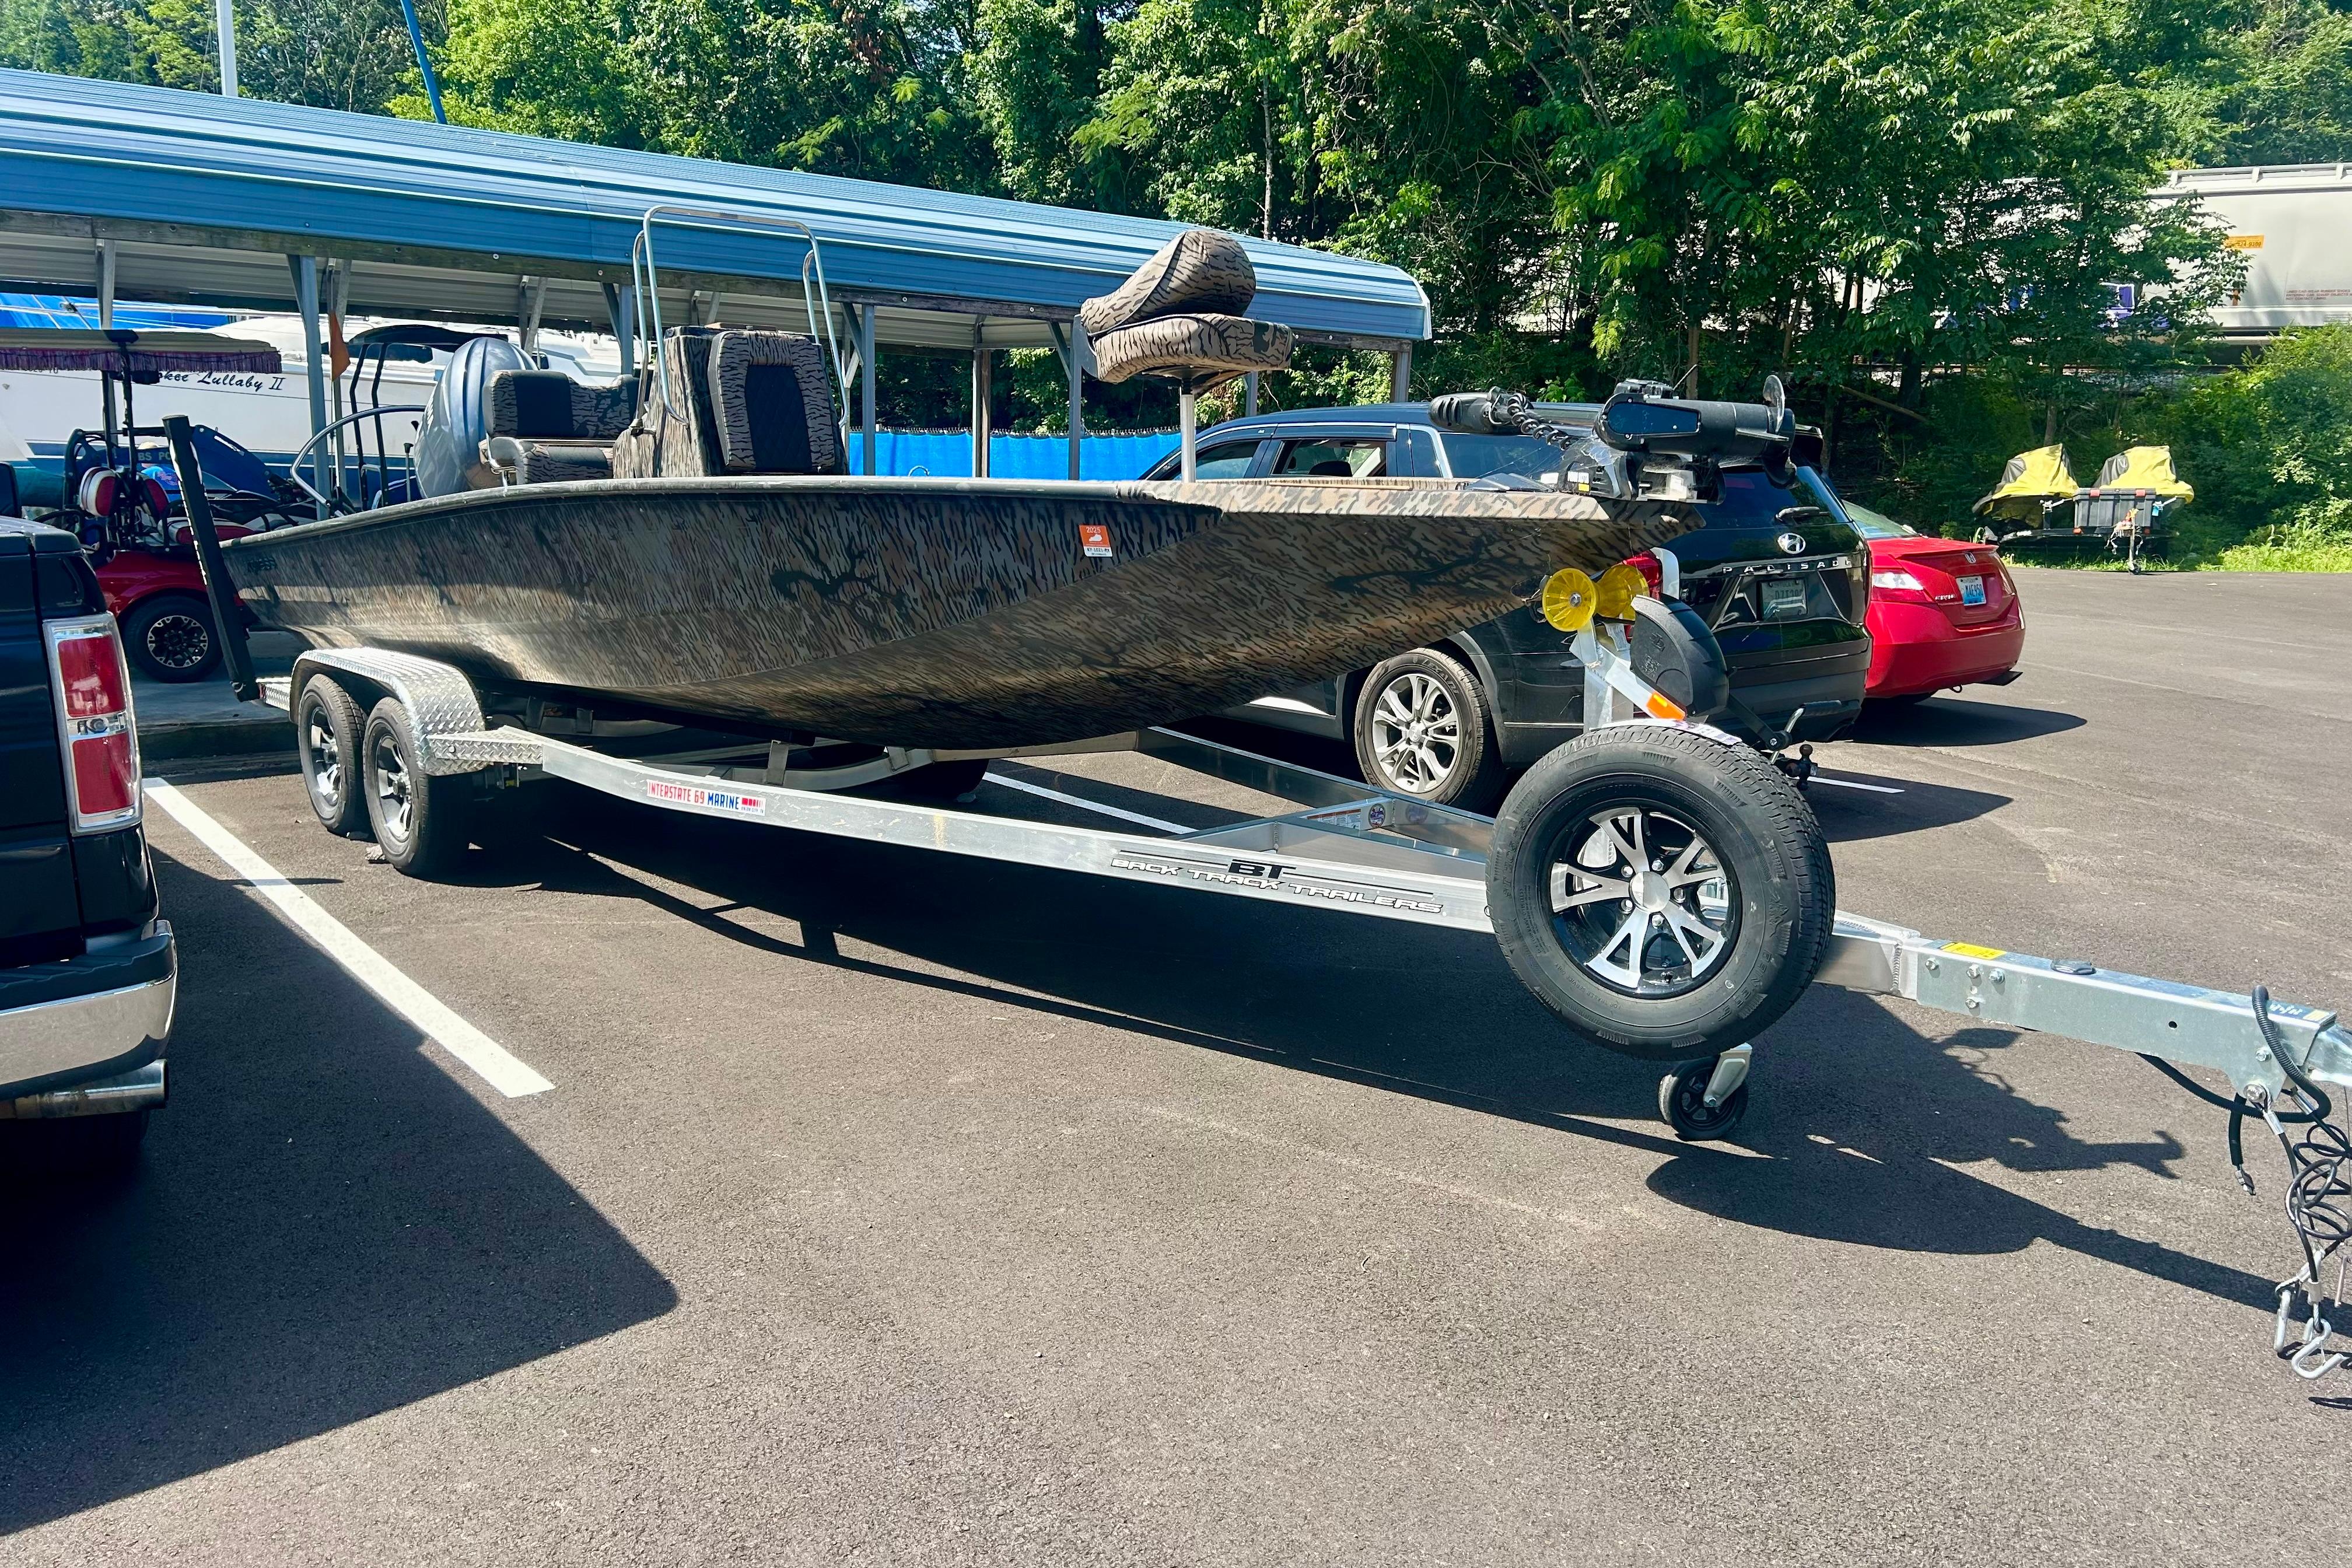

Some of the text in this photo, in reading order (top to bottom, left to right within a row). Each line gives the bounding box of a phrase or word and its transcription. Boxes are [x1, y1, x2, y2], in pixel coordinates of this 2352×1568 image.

[197, 371, 262, 392] Lullaby
[648, 782, 740, 810] INTERSTATE 69 MARINE
[1111, 858, 1444, 914] BACK TRACK TRAILERS
